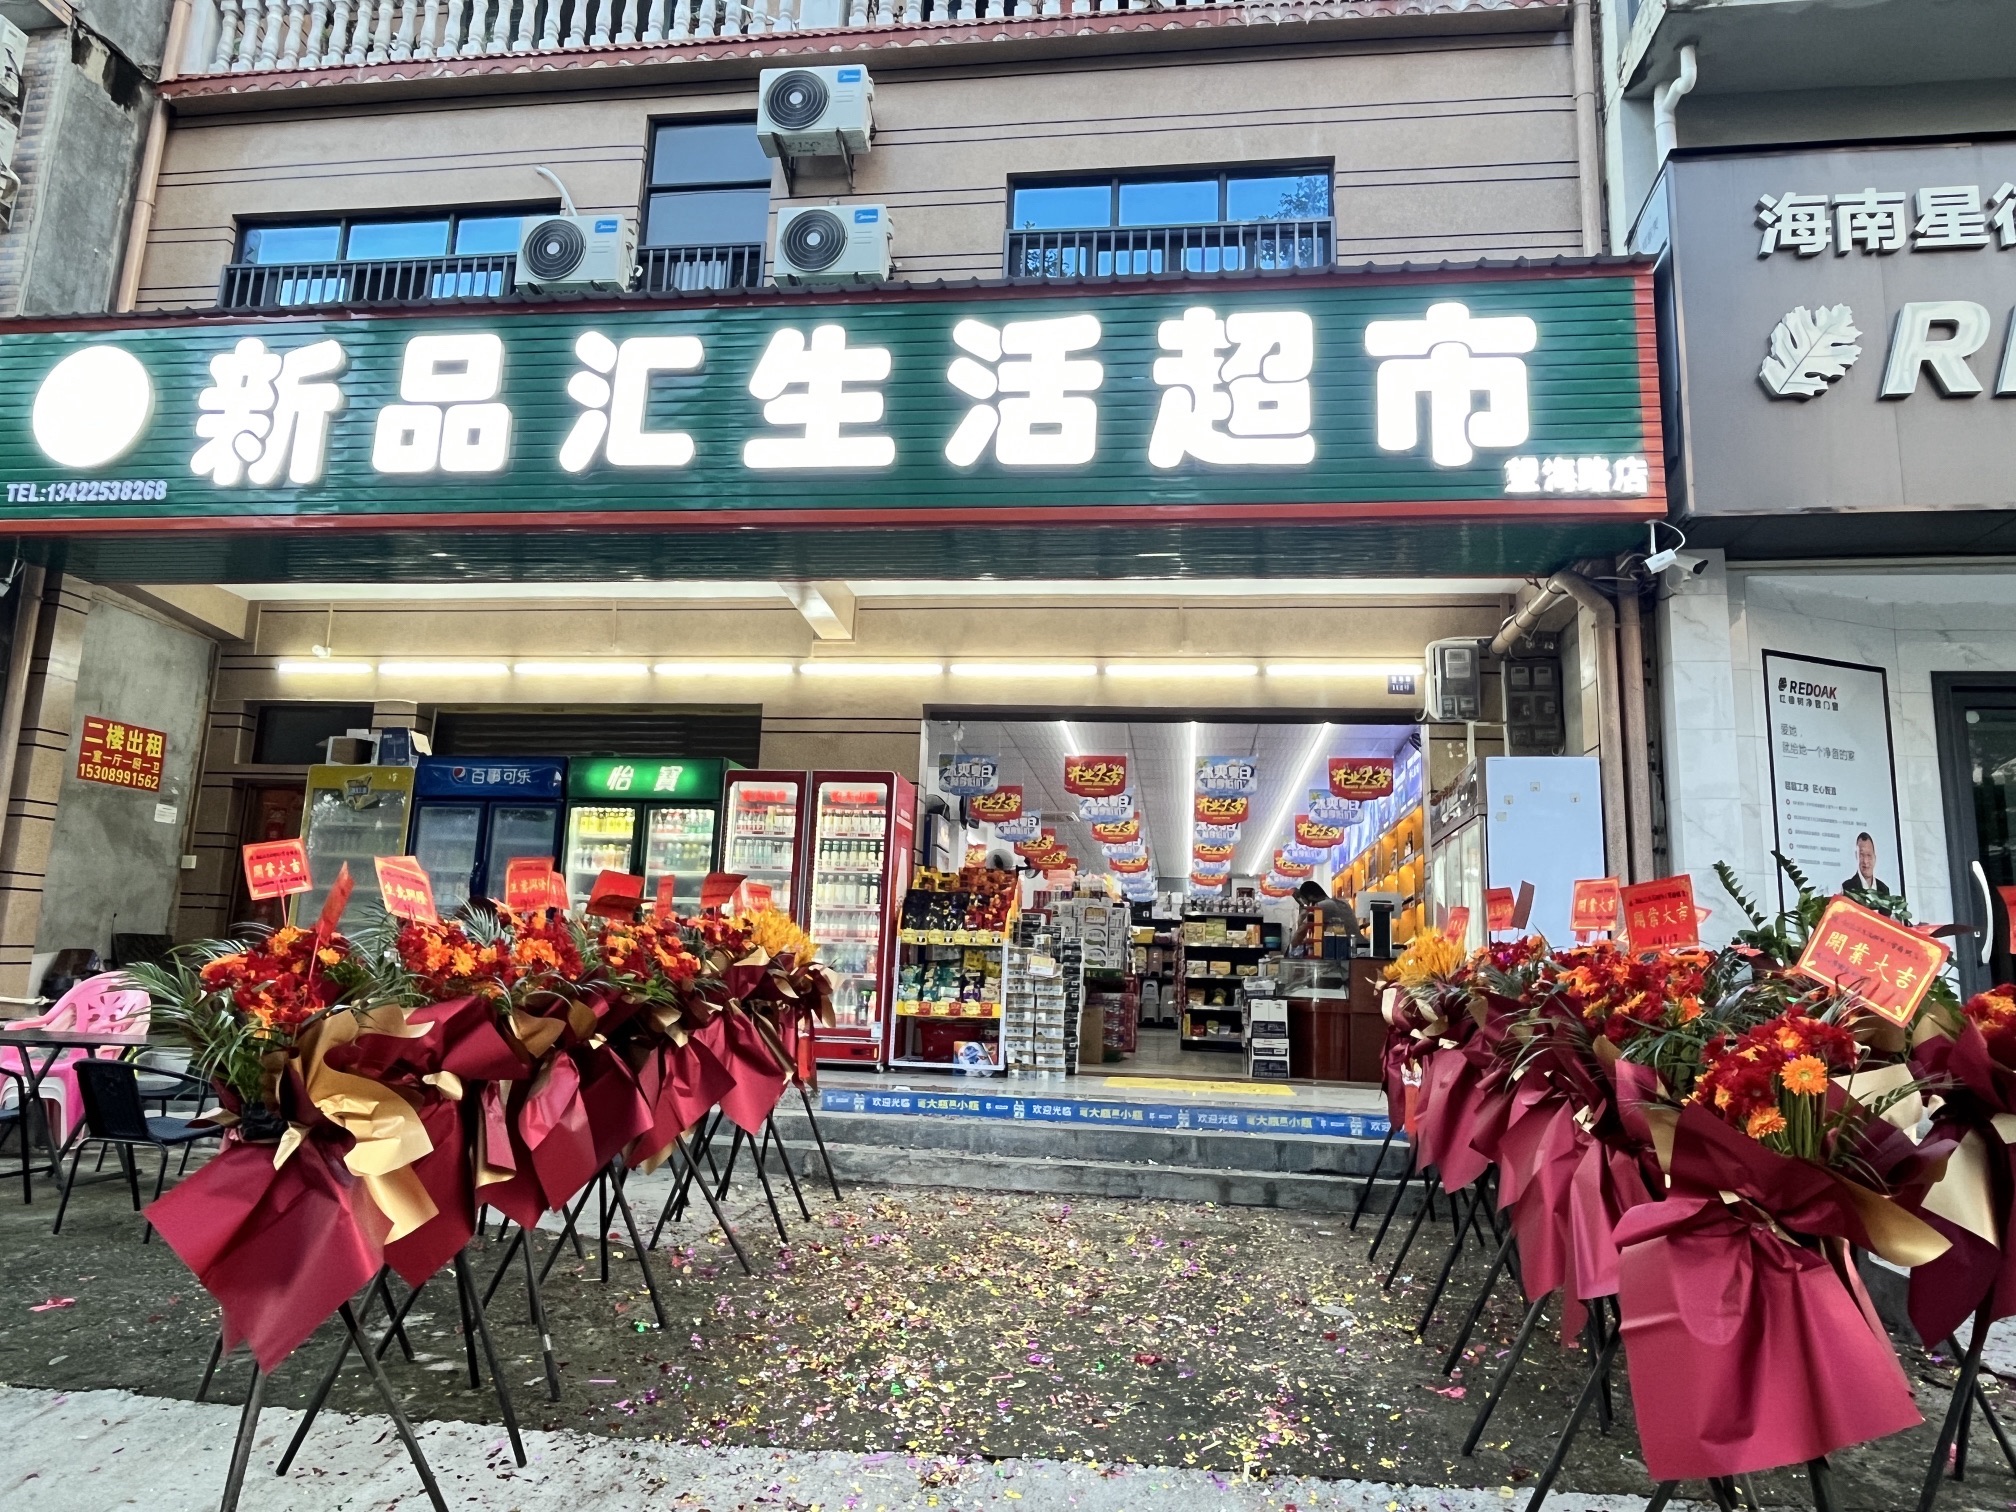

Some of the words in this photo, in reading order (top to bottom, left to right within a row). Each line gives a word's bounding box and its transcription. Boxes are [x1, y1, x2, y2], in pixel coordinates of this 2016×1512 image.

[1880, 300, 2016, 400] R
[190, 303, 1538, 487] 新品汇生活超市
[6, 480, 168, 502] TEL:13422538268
[1789, 680, 1837, 700] REDOAK
[84, 722, 163, 758] 二楼出租
[82, 750, 160, 774] 一室一厅一厨一卫
[80, 763, 160, 789] 15308991562
[471, 768, 531, 785] 百事可乐
[1825, 931, 1917, 989] 開業大吉
[872, 1096, 911, 1109] 欢迎光临
[1032, 1104, 1072, 1117] 欢迎光临
[1197, 1113, 1239, 1126] 欢迎光临
